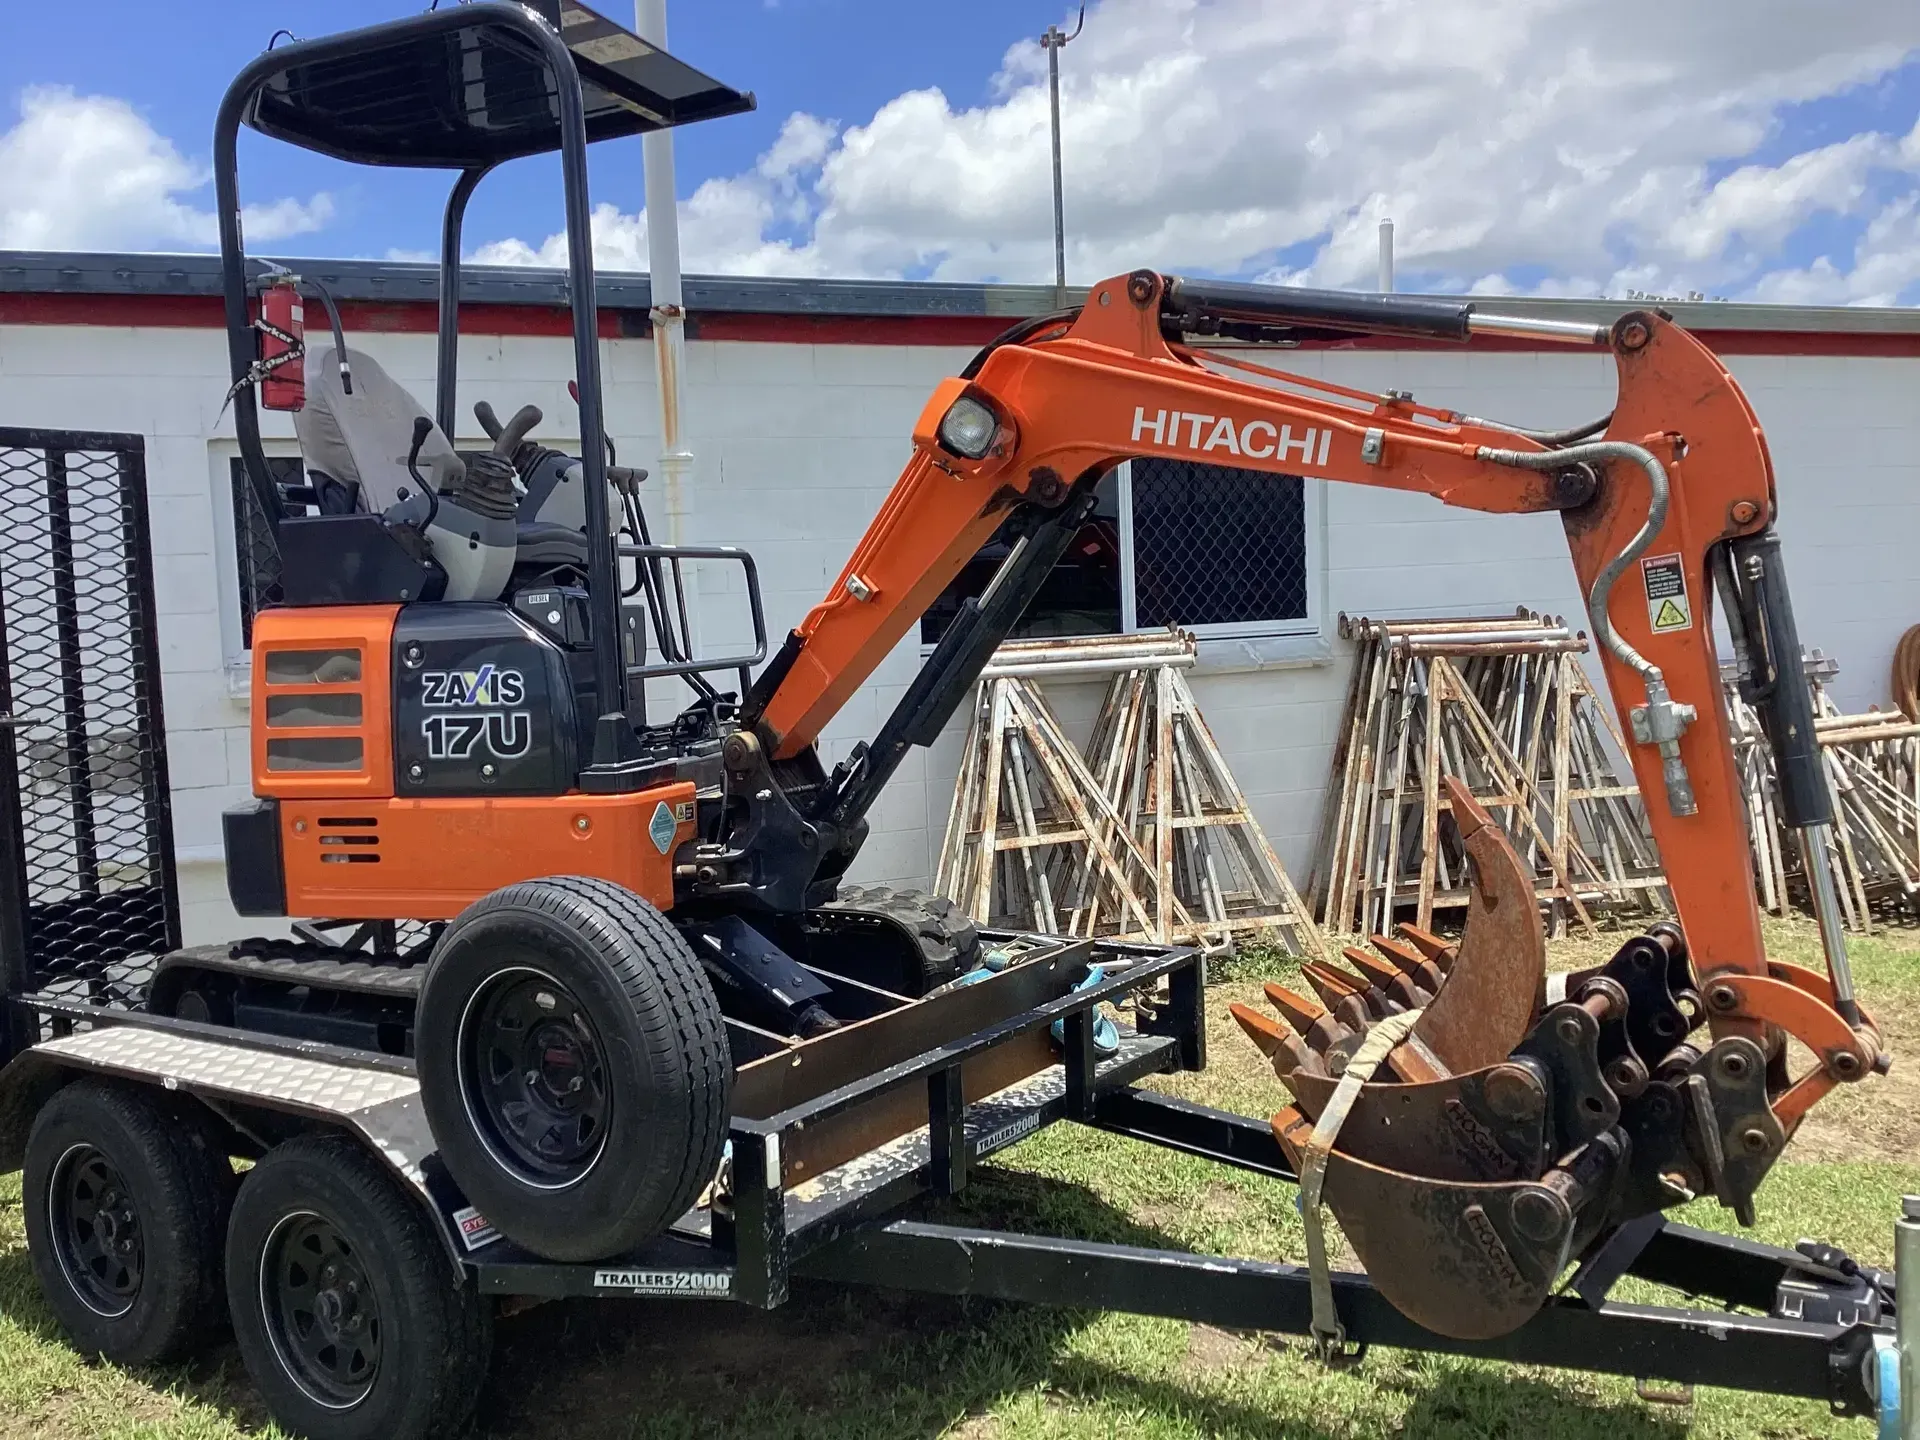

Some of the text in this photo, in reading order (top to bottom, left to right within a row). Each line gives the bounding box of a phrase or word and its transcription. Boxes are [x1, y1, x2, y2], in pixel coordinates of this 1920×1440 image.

[1131, 406, 1332, 466] HITACHI
[530, 595, 548, 603] DIESEL
[422, 663, 525, 707] ZAXIS
[421, 712, 532, 759] 17U
[979, 1126, 1015, 1151] TRAILERS
[1015, 1112, 1040, 1135] 2000
[463, 1216, 489, 1232] 2YE
[600, 1273, 730, 1290] TRAILERS 2000
[633, 1287, 671, 1295] AUSTRALIA'S
